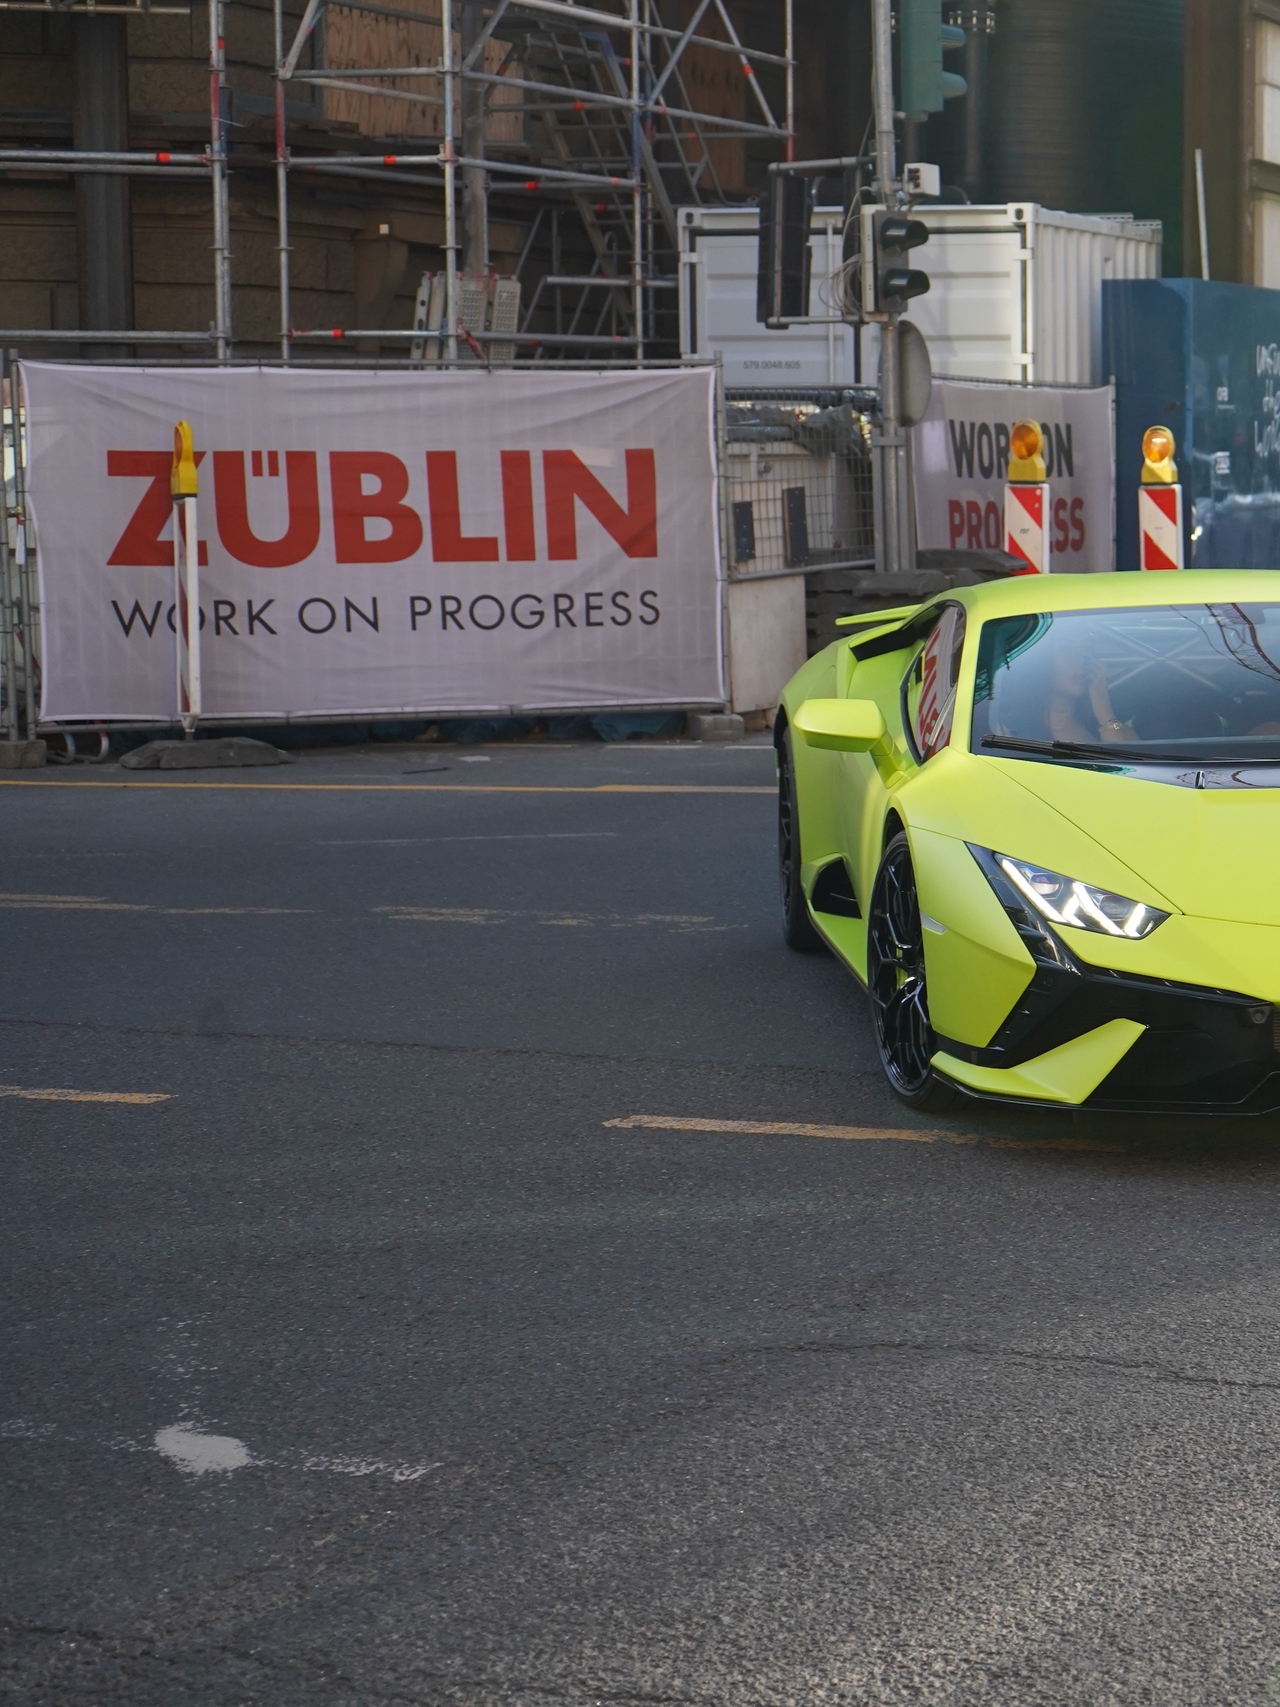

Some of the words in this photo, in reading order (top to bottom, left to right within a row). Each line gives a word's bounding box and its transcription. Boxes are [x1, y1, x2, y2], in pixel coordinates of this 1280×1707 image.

[949, 419, 1014, 479] WOR
[106, 448, 659, 568] ZÜBLIN
[948, 497, 1085, 552] PROSS
[111, 599, 277, 638] WORK
[298, 597, 379, 634] ON
[410, 590, 660, 632] PROGRESS
